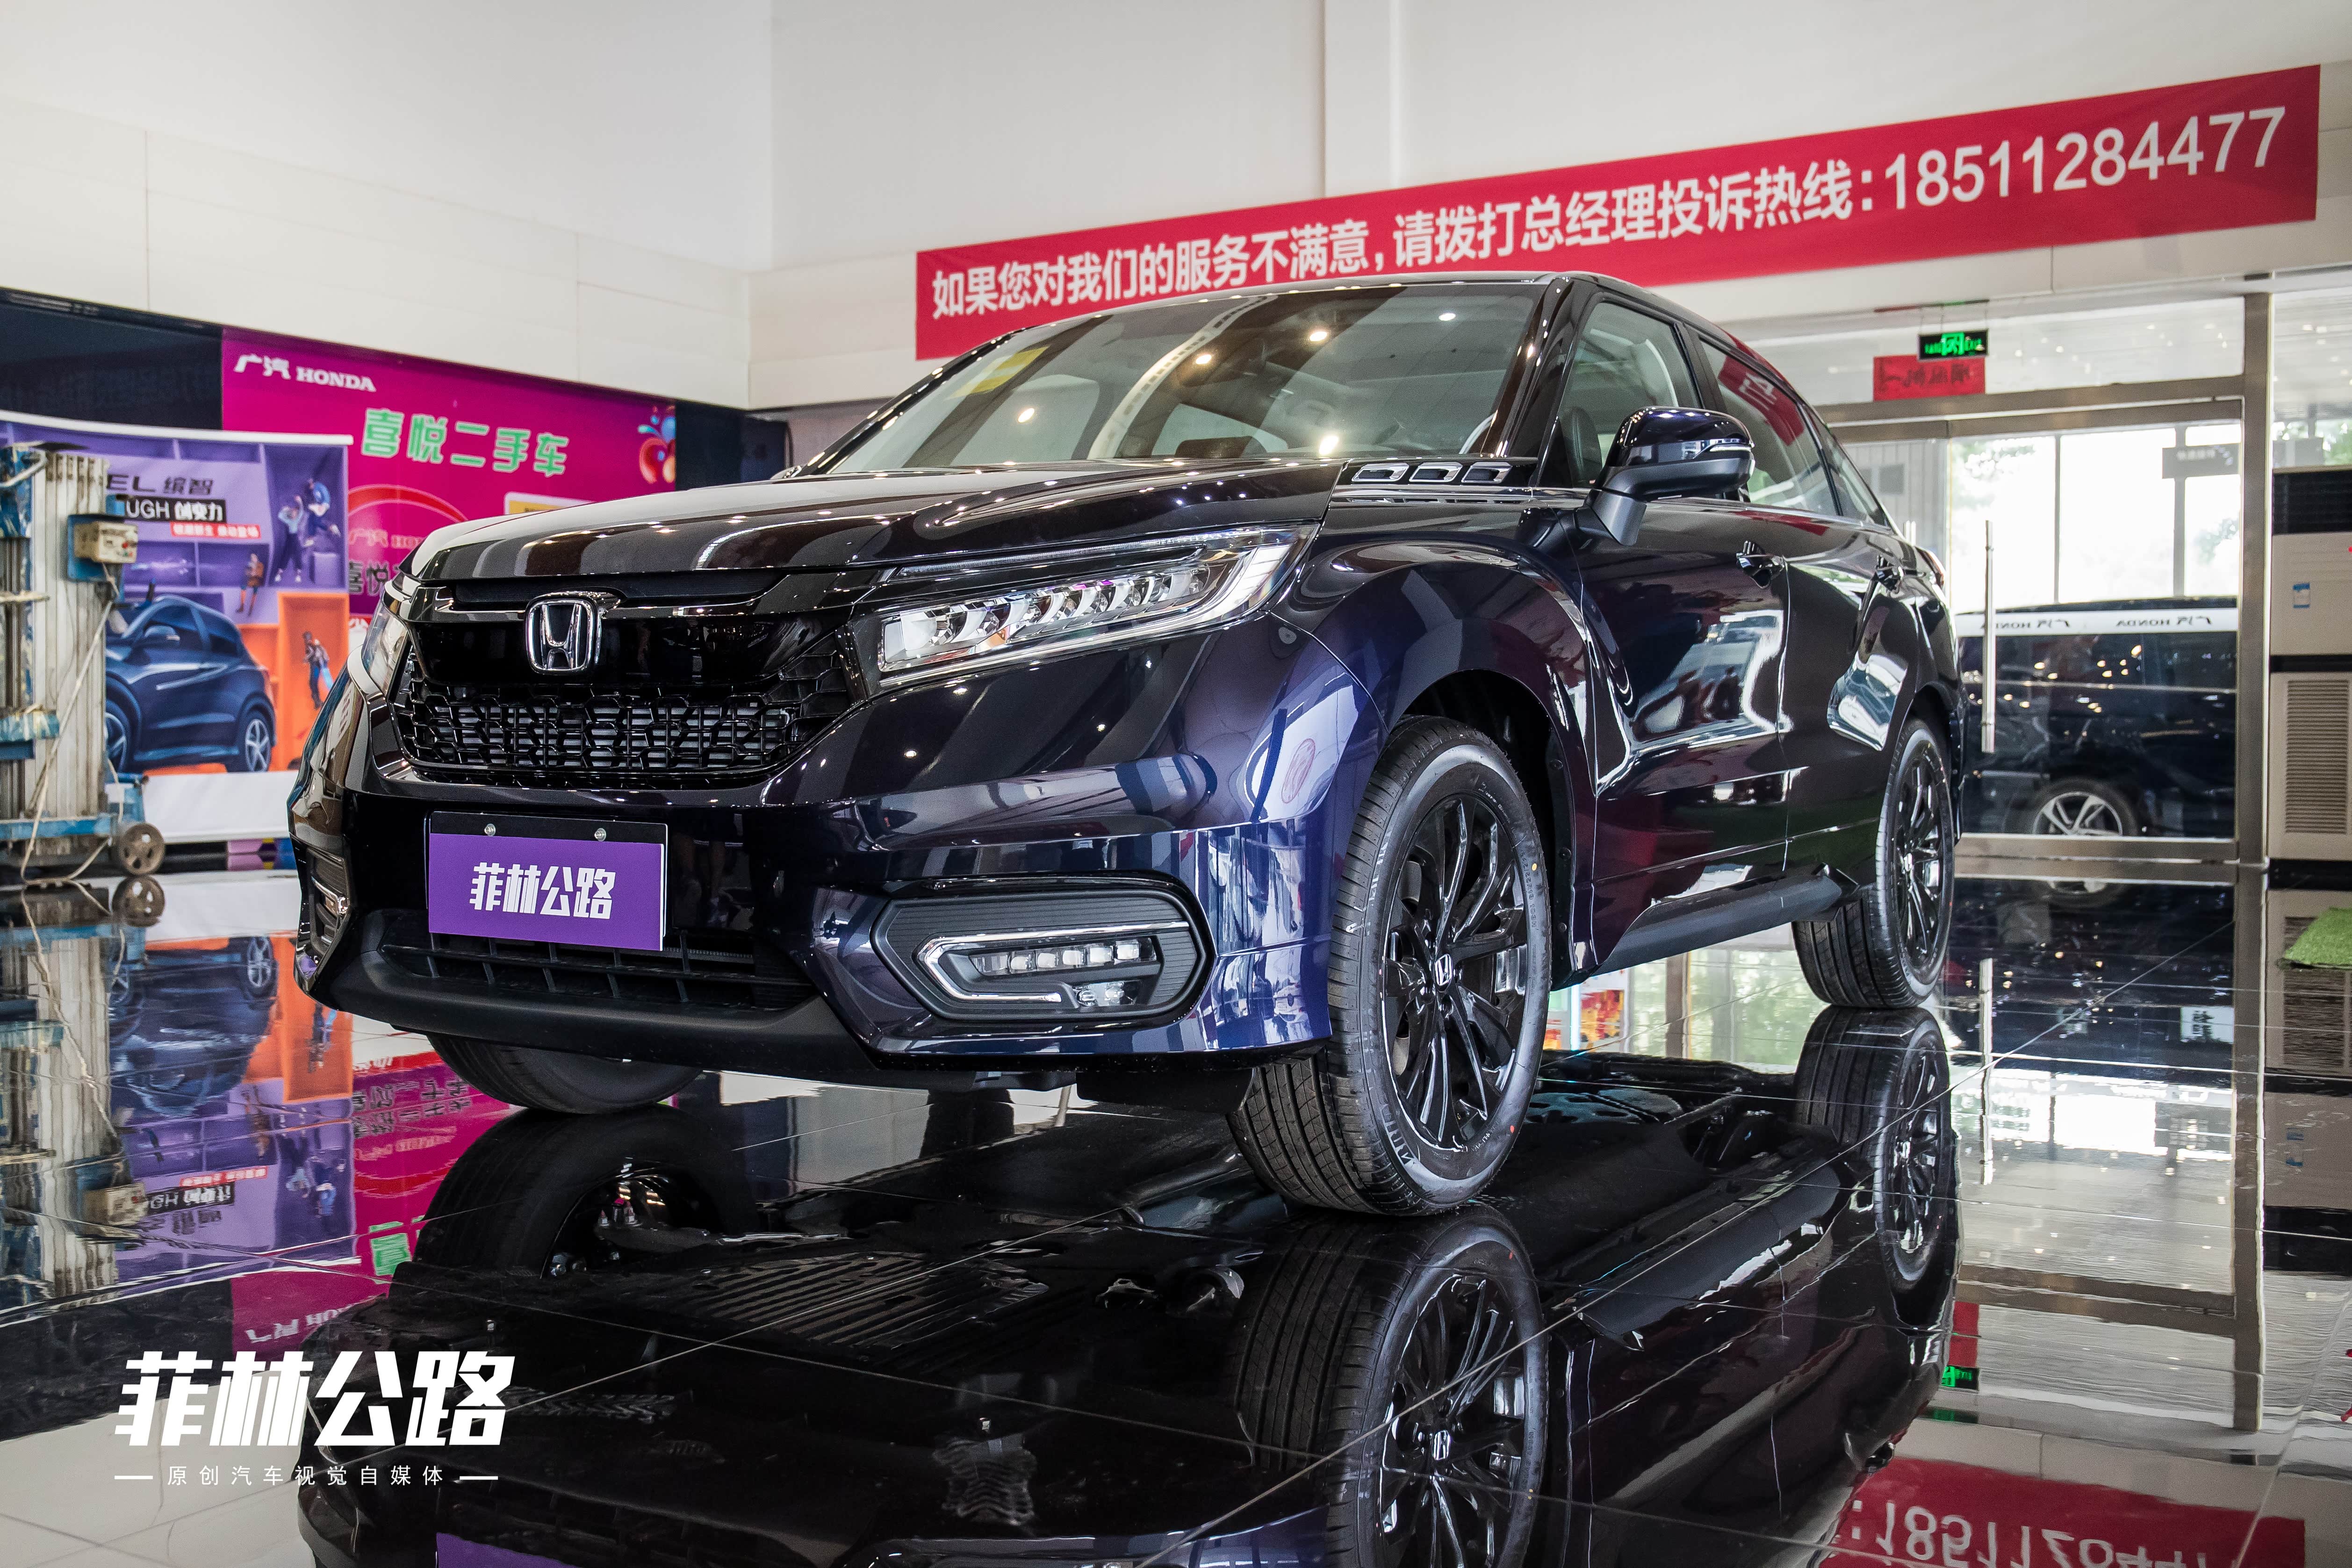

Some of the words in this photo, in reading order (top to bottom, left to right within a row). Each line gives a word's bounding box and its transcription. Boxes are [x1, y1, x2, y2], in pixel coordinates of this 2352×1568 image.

[234, 354, 292, 381] 广汽
[295, 365, 377, 393] HONDA
[361, 408, 569, 478] 喜悦二手车
[106, 474, 155, 492] EL
[125, 498, 170, 519] UGH
[348, 560, 402, 597] 喜悦
[469, 862, 616, 919] 菲林公路
